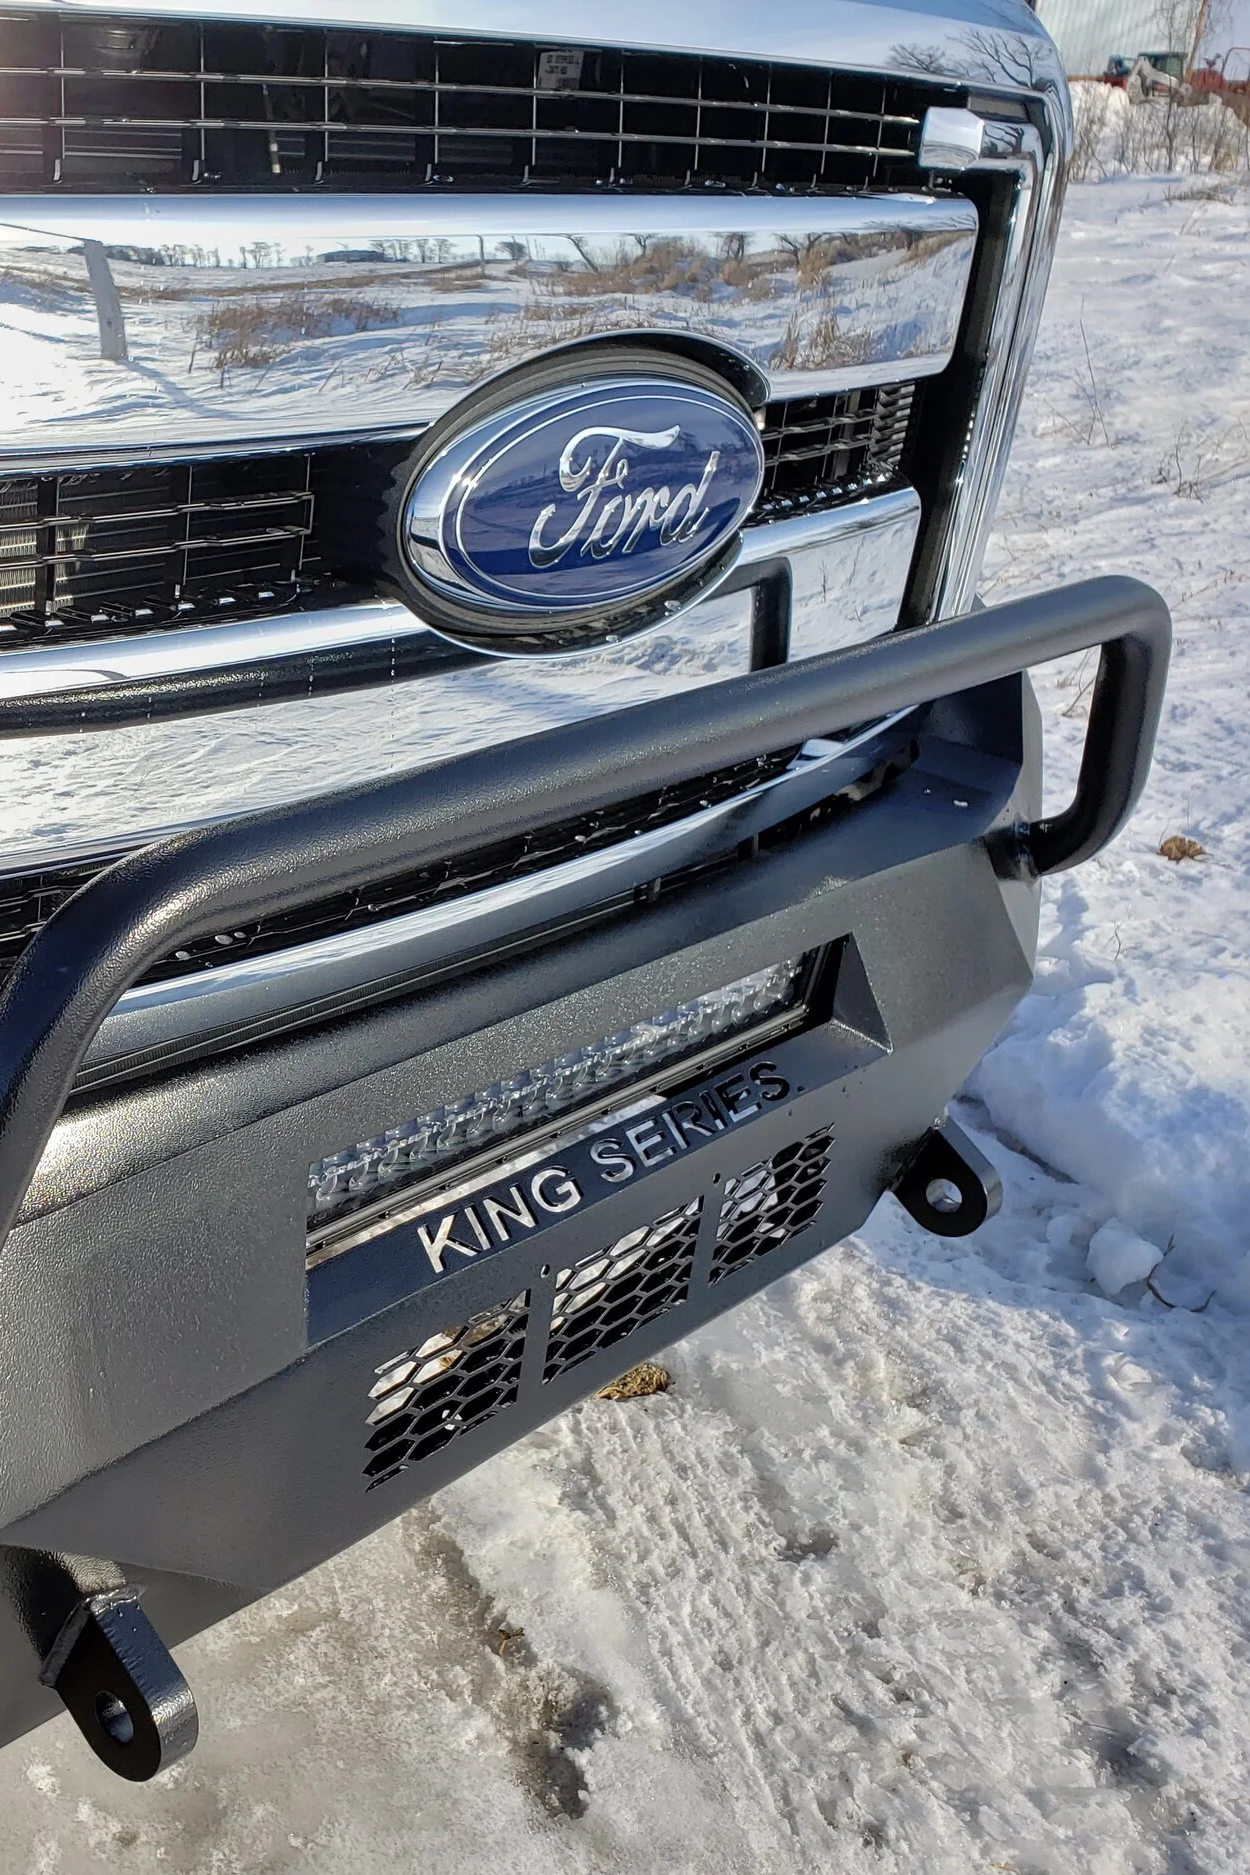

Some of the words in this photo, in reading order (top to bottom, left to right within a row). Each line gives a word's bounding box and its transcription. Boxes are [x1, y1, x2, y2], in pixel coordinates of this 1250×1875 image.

[528, 424, 721, 569] Ford
[416, 1165, 583, 1274] KING
[589, 1060, 792, 1184] SERIES
